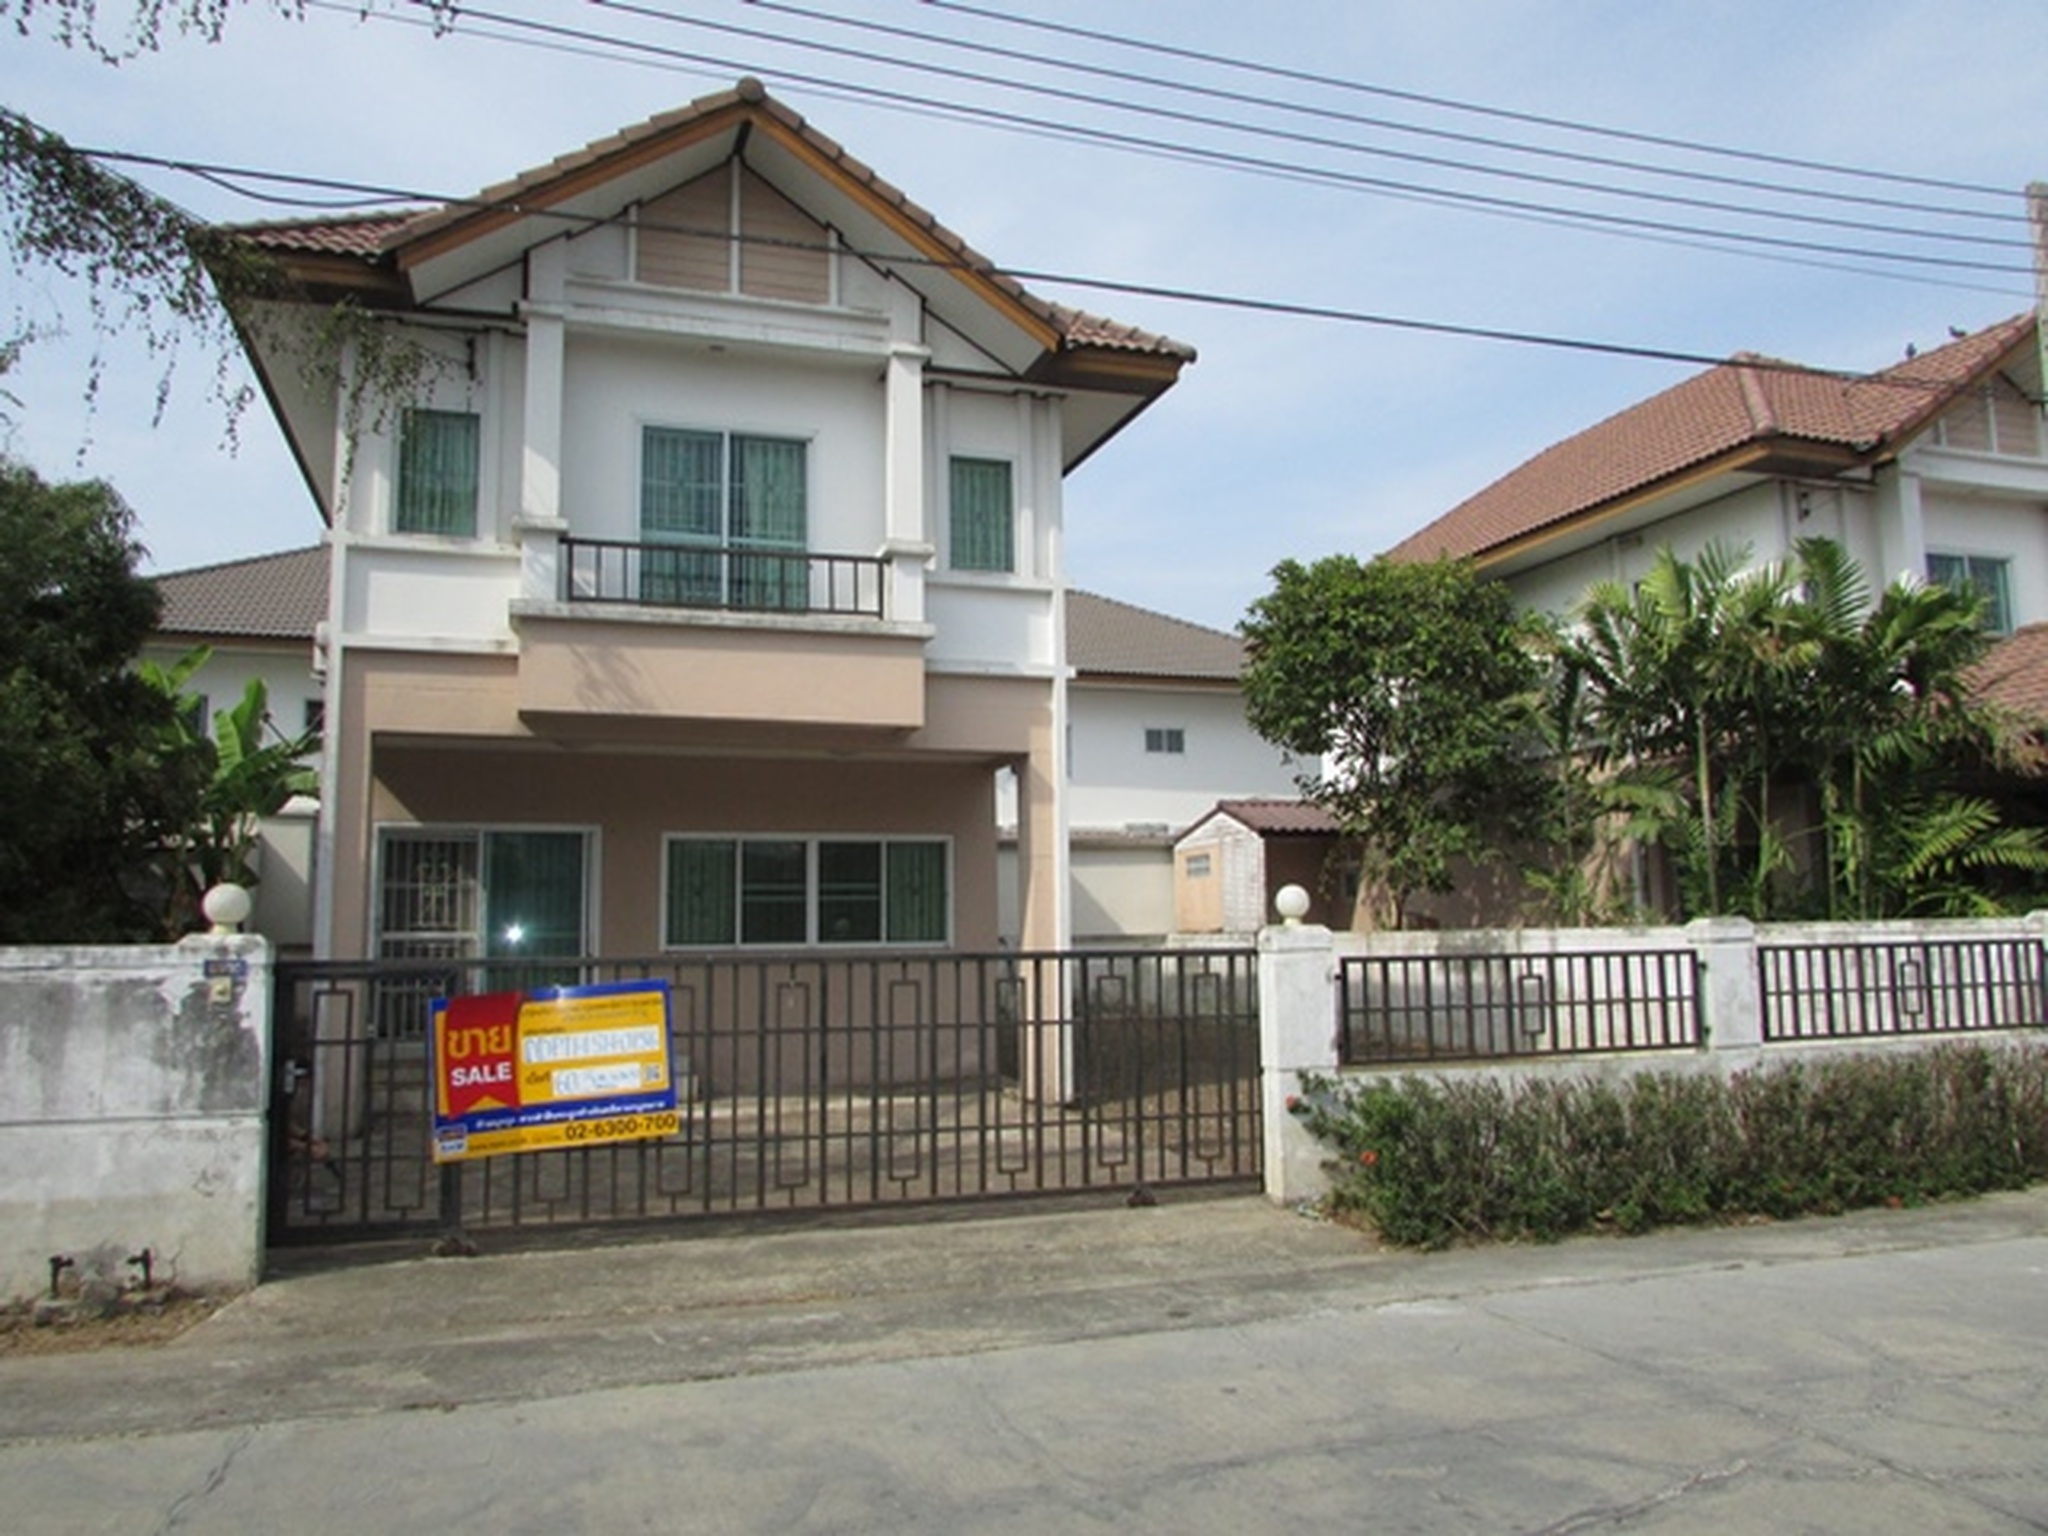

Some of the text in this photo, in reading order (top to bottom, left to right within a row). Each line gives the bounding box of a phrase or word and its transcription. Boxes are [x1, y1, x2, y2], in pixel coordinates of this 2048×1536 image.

[448, 1024, 511, 1058] ขาย
[451, 1061, 512, 1087] SALE
[565, 1113, 677, 1141] 02-6300-700
